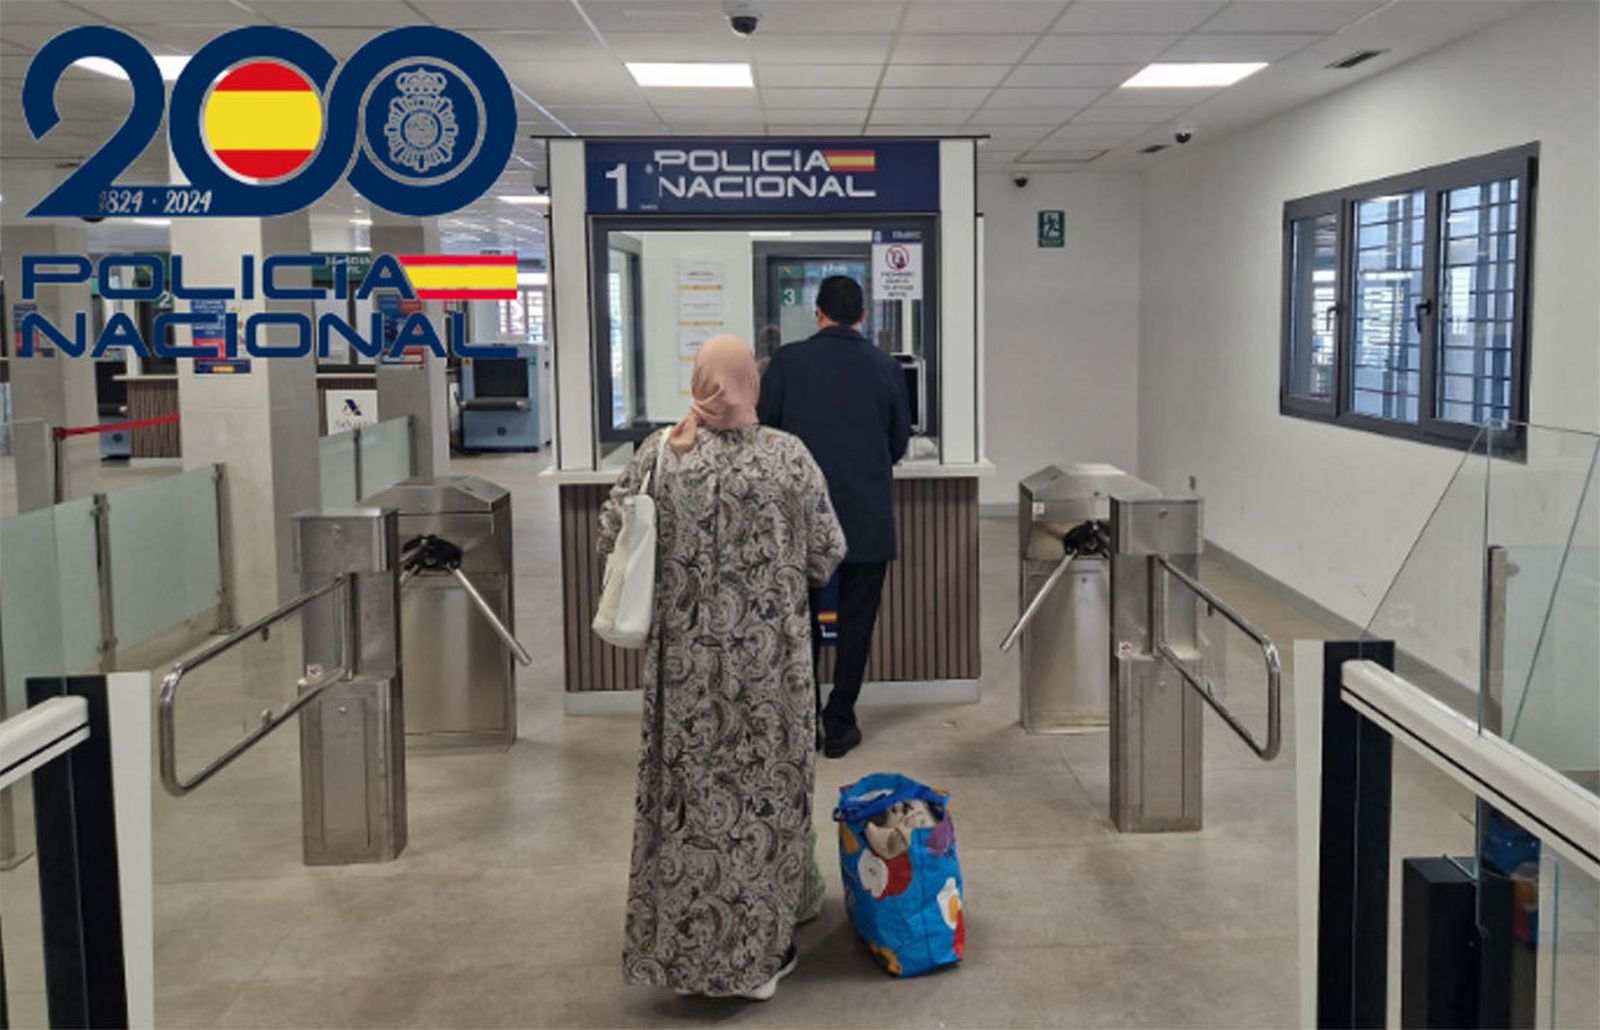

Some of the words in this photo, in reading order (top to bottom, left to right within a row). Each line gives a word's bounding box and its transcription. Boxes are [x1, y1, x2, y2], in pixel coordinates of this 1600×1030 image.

[654, 150, 830, 172] POLICIA
[605, 163, 628, 210] 1
[659, 175, 877, 198] NACIONAL
[783, 288, 796, 305] 3
